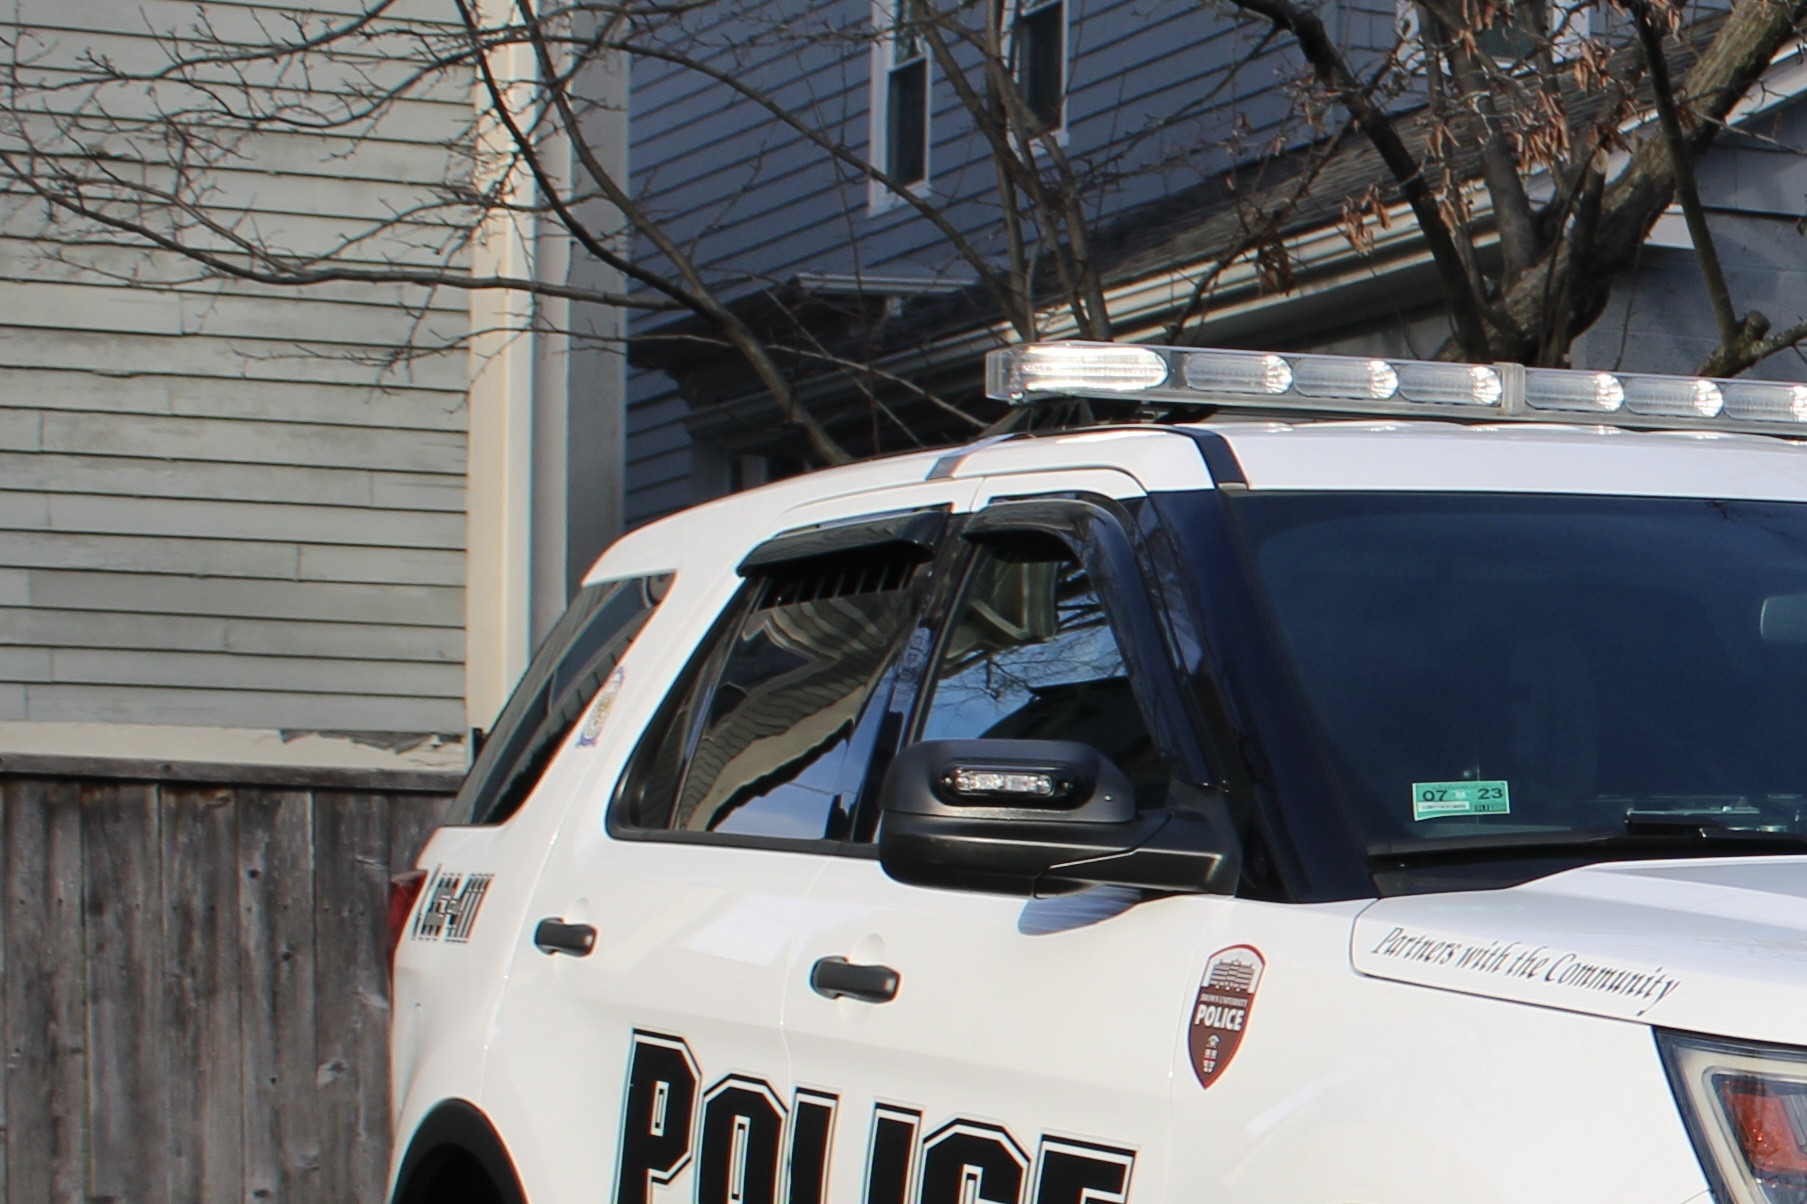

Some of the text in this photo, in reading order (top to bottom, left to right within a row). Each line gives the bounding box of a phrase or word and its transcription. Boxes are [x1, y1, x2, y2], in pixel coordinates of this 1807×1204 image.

[1422, 787, 1504, 802] 07 23
[1371, 926, 1682, 1017] Partners with the Community
[1194, 1003, 1246, 1032] POLICE
